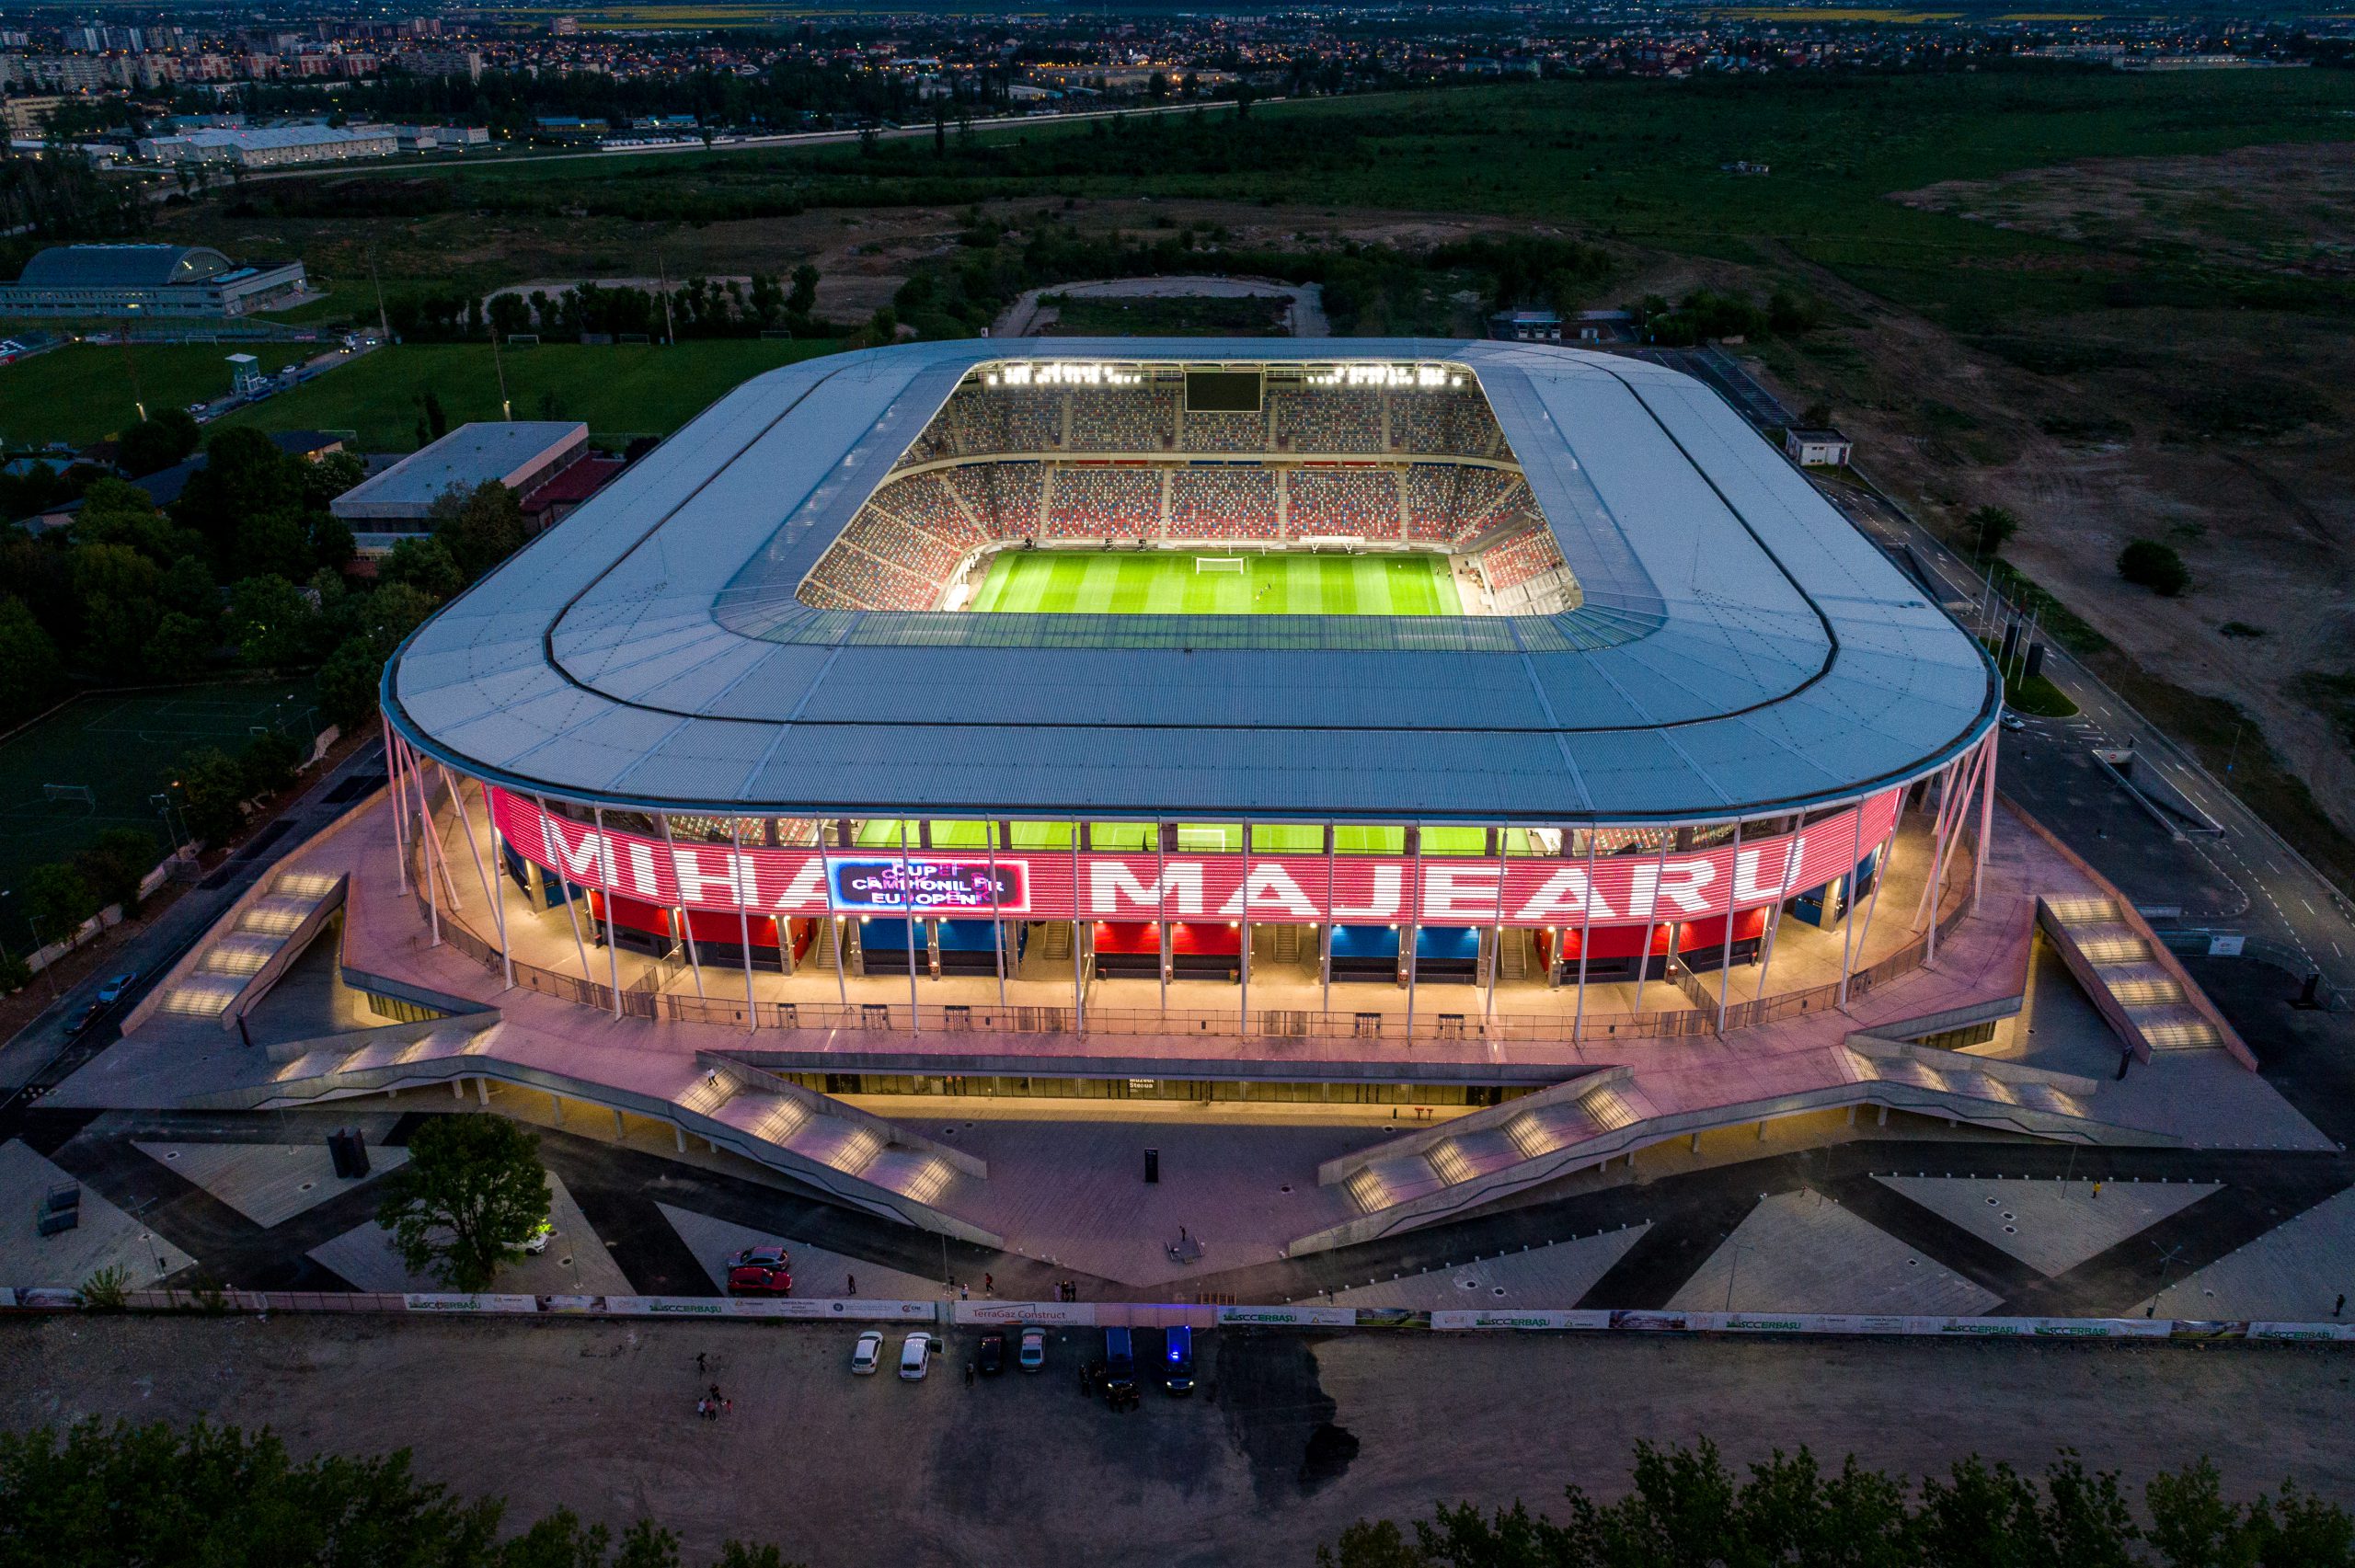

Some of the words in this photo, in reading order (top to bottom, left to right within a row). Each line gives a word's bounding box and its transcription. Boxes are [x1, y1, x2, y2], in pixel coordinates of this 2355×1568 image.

[1090, 838, 1806, 919] MAJEARU
[973, 1310, 1016, 1319] TerraGaz
[1017, 1310, 1066, 1320] Construct
